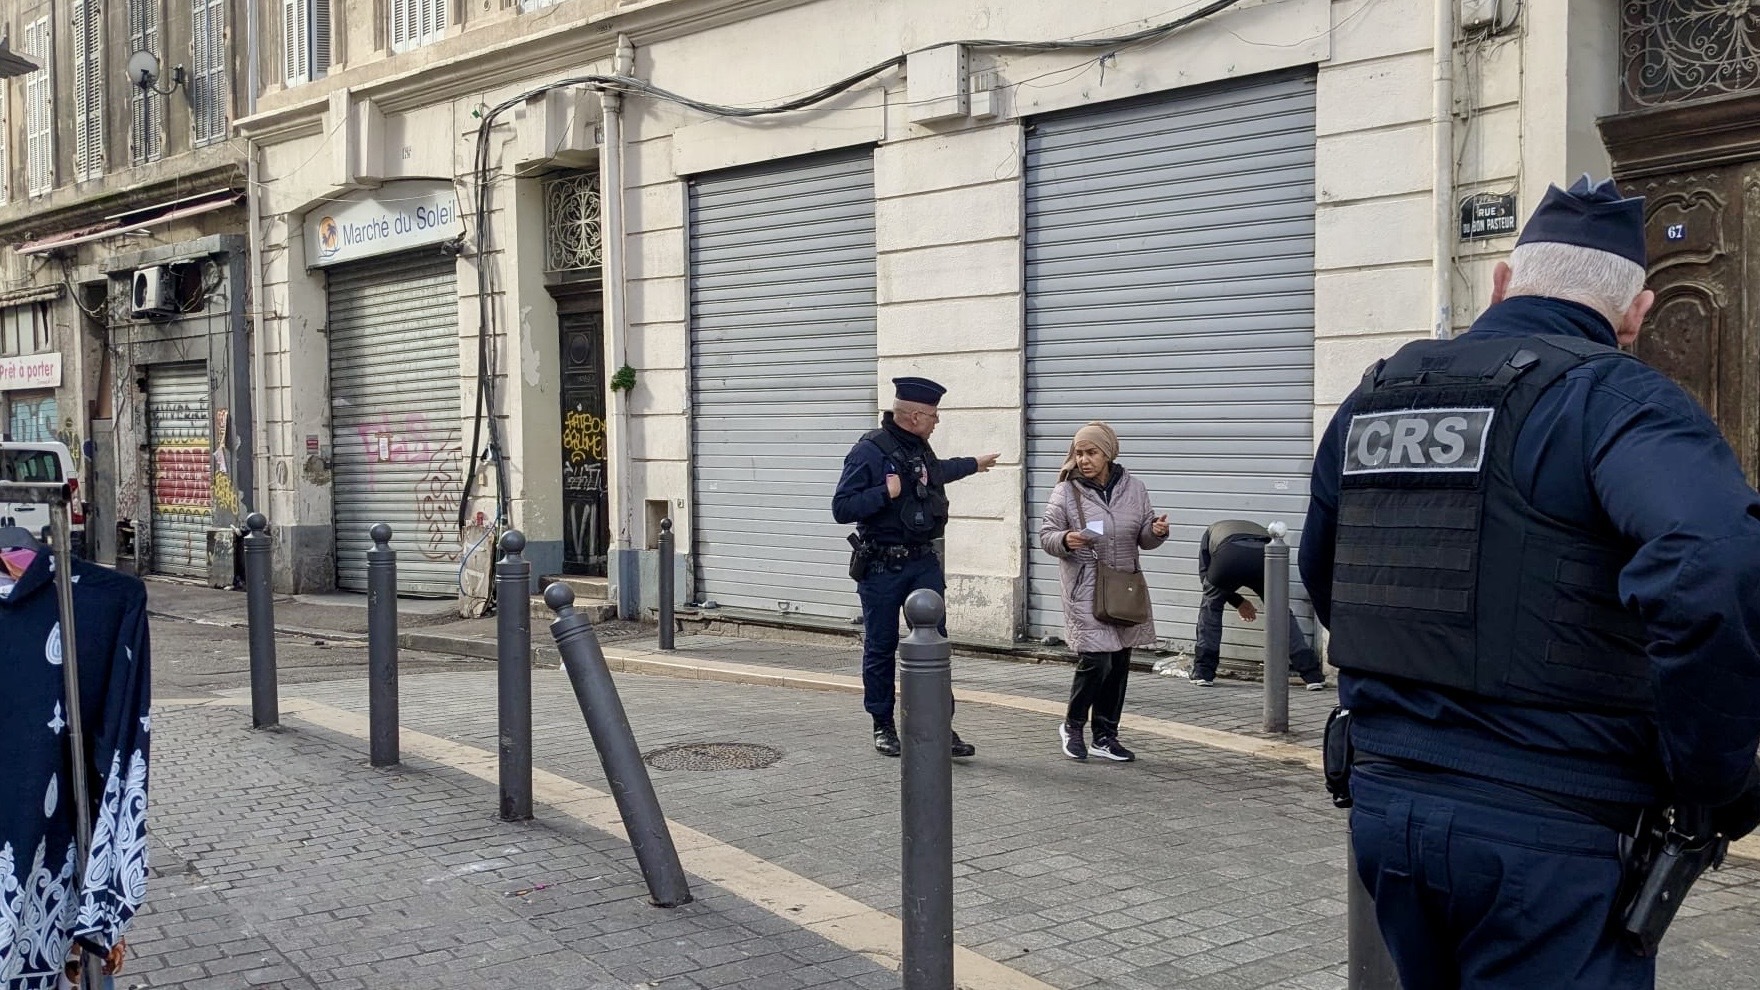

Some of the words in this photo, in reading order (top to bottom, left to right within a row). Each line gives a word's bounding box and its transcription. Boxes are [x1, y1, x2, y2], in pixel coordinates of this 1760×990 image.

[1478, 207, 1496, 217] RUE
[342, 215, 390, 246] Marché
[394, 211, 412, 235] du
[416, 199, 456, 231] Soleil
[1486, 216, 1515, 230] PASTEUR
[1667, 224, 1683, 239] 67
[19, 360, 24, 378] à
[27, 361, 54, 382] porter
[1357, 416, 1468, 466] CRS
